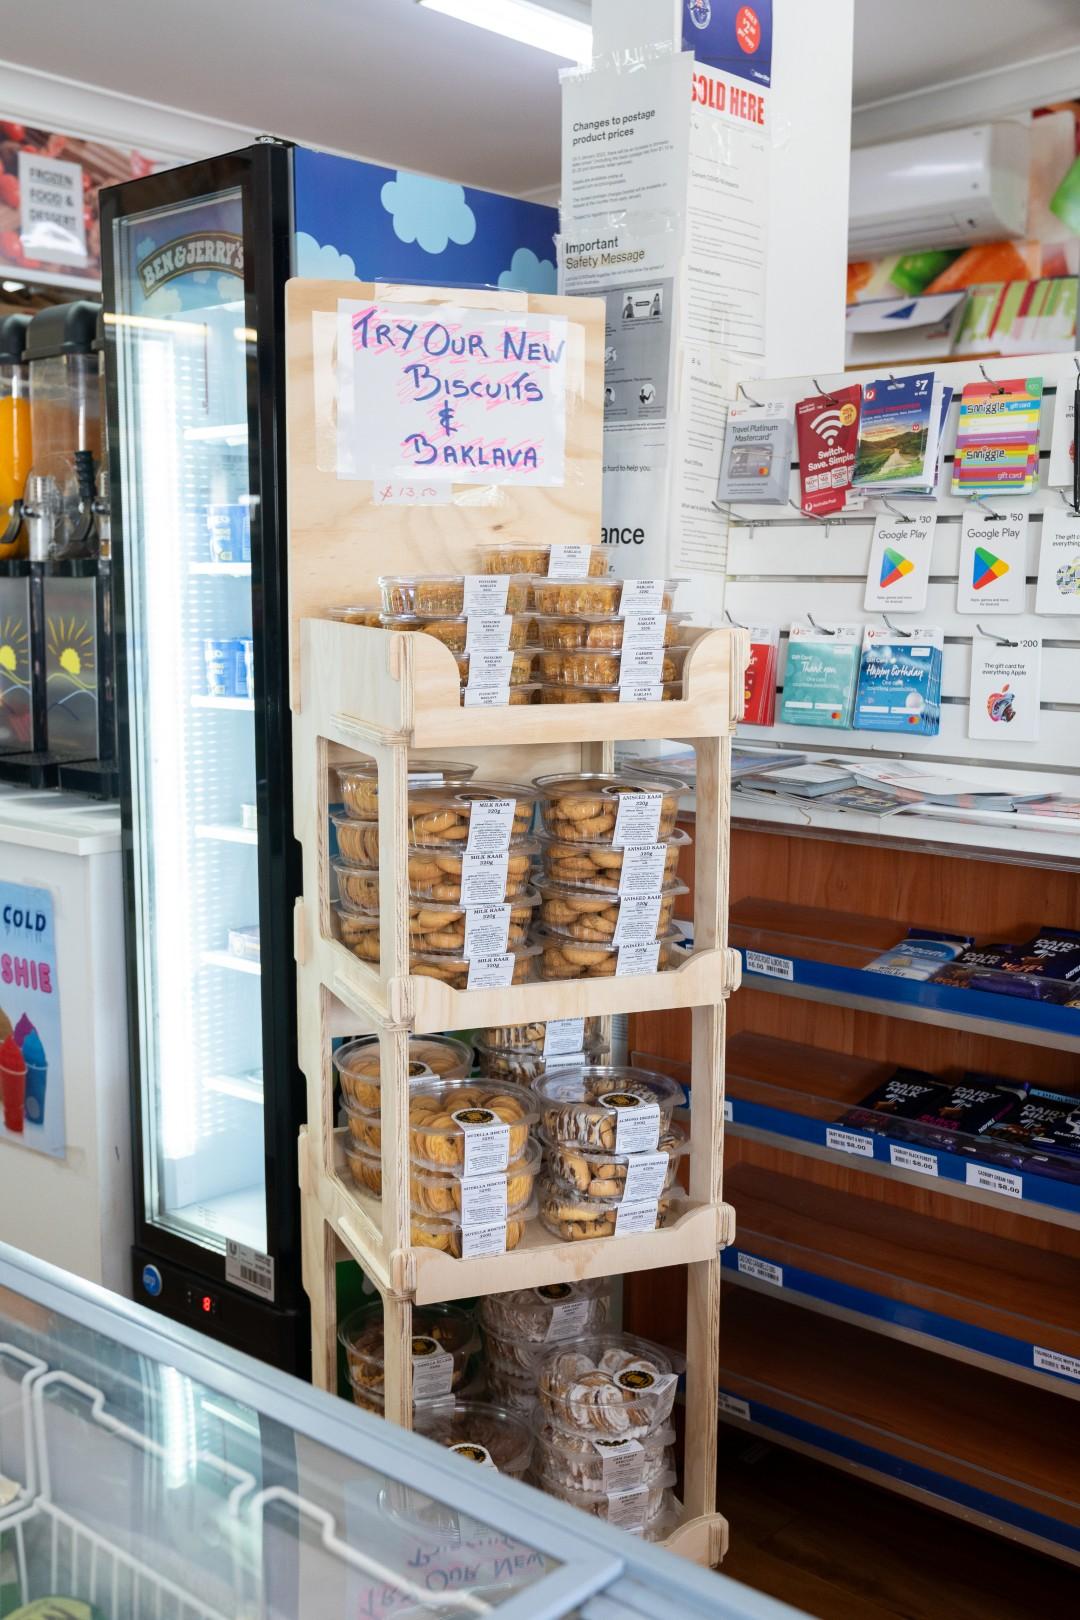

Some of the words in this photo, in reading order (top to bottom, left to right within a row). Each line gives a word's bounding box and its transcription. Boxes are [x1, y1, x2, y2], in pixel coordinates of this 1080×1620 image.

[730, 86, 765, 125] HERE
[572, 118, 610, 133] Changes
[612, 116, 621, 126] to
[622, 109, 656, 125] postage
[572, 131, 606, 146] product
[608, 127, 635, 140] prices
[29, 167, 73, 187] FROZEN
[30, 188, 62, 208] FOOD
[66, 194, 74, 208] &
[565, 236, 619, 254] Important
[566, 256, 599, 270] Safety
[601, 249, 645, 265] Message
[353, 309, 418, 349] TRY
[424, 323, 489, 358] OUR
[503, 331, 565, 364] NEW
[404, 364, 544, 402] BISCUITS
[915, 379, 929, 391] $7
[967, 401, 1005, 415] smiggle
[732, 426, 750, 434] Travel
[750, 424, 779, 432] Platinum
[404, 433, 538, 468] BAKLAVA
[818, 446, 845, 460] Switch.
[966, 449, 1005, 462] smiggle
[608, 464, 620, 473] hard
[626, 464, 637, 474] help
[808, 460, 828, 472] Save.
[828, 453, 856, 467] Simple.
[997, 472, 1008, 480] gift
[1008, 471, 1022, 479] card
[919, 515, 932, 524] $30
[1010, 512, 1024, 522] $50
[878, 530, 908, 541] Google
[909, 529, 927, 541] Play
[967, 528, 1000, 540] Google
[1001, 527, 1020, 539] Play
[1020, 640, 1038, 648] $200
[801, 661, 822, 674] Thank
[866, 664, 889, 681] Happy
[890, 663, 923, 678] Birthday
[3, 905, 47, 932] COLD
[886, 1086, 925, 1098] MILK
[888, 1080, 933, 1094] DAIRY
[954, 1086, 1001, 1099] DAIRY
[951, 1091, 985, 1104] MILK
[1020, 1108, 1054, 1123] MILK
[1023, 1103, 1067, 1119] DAIRY
